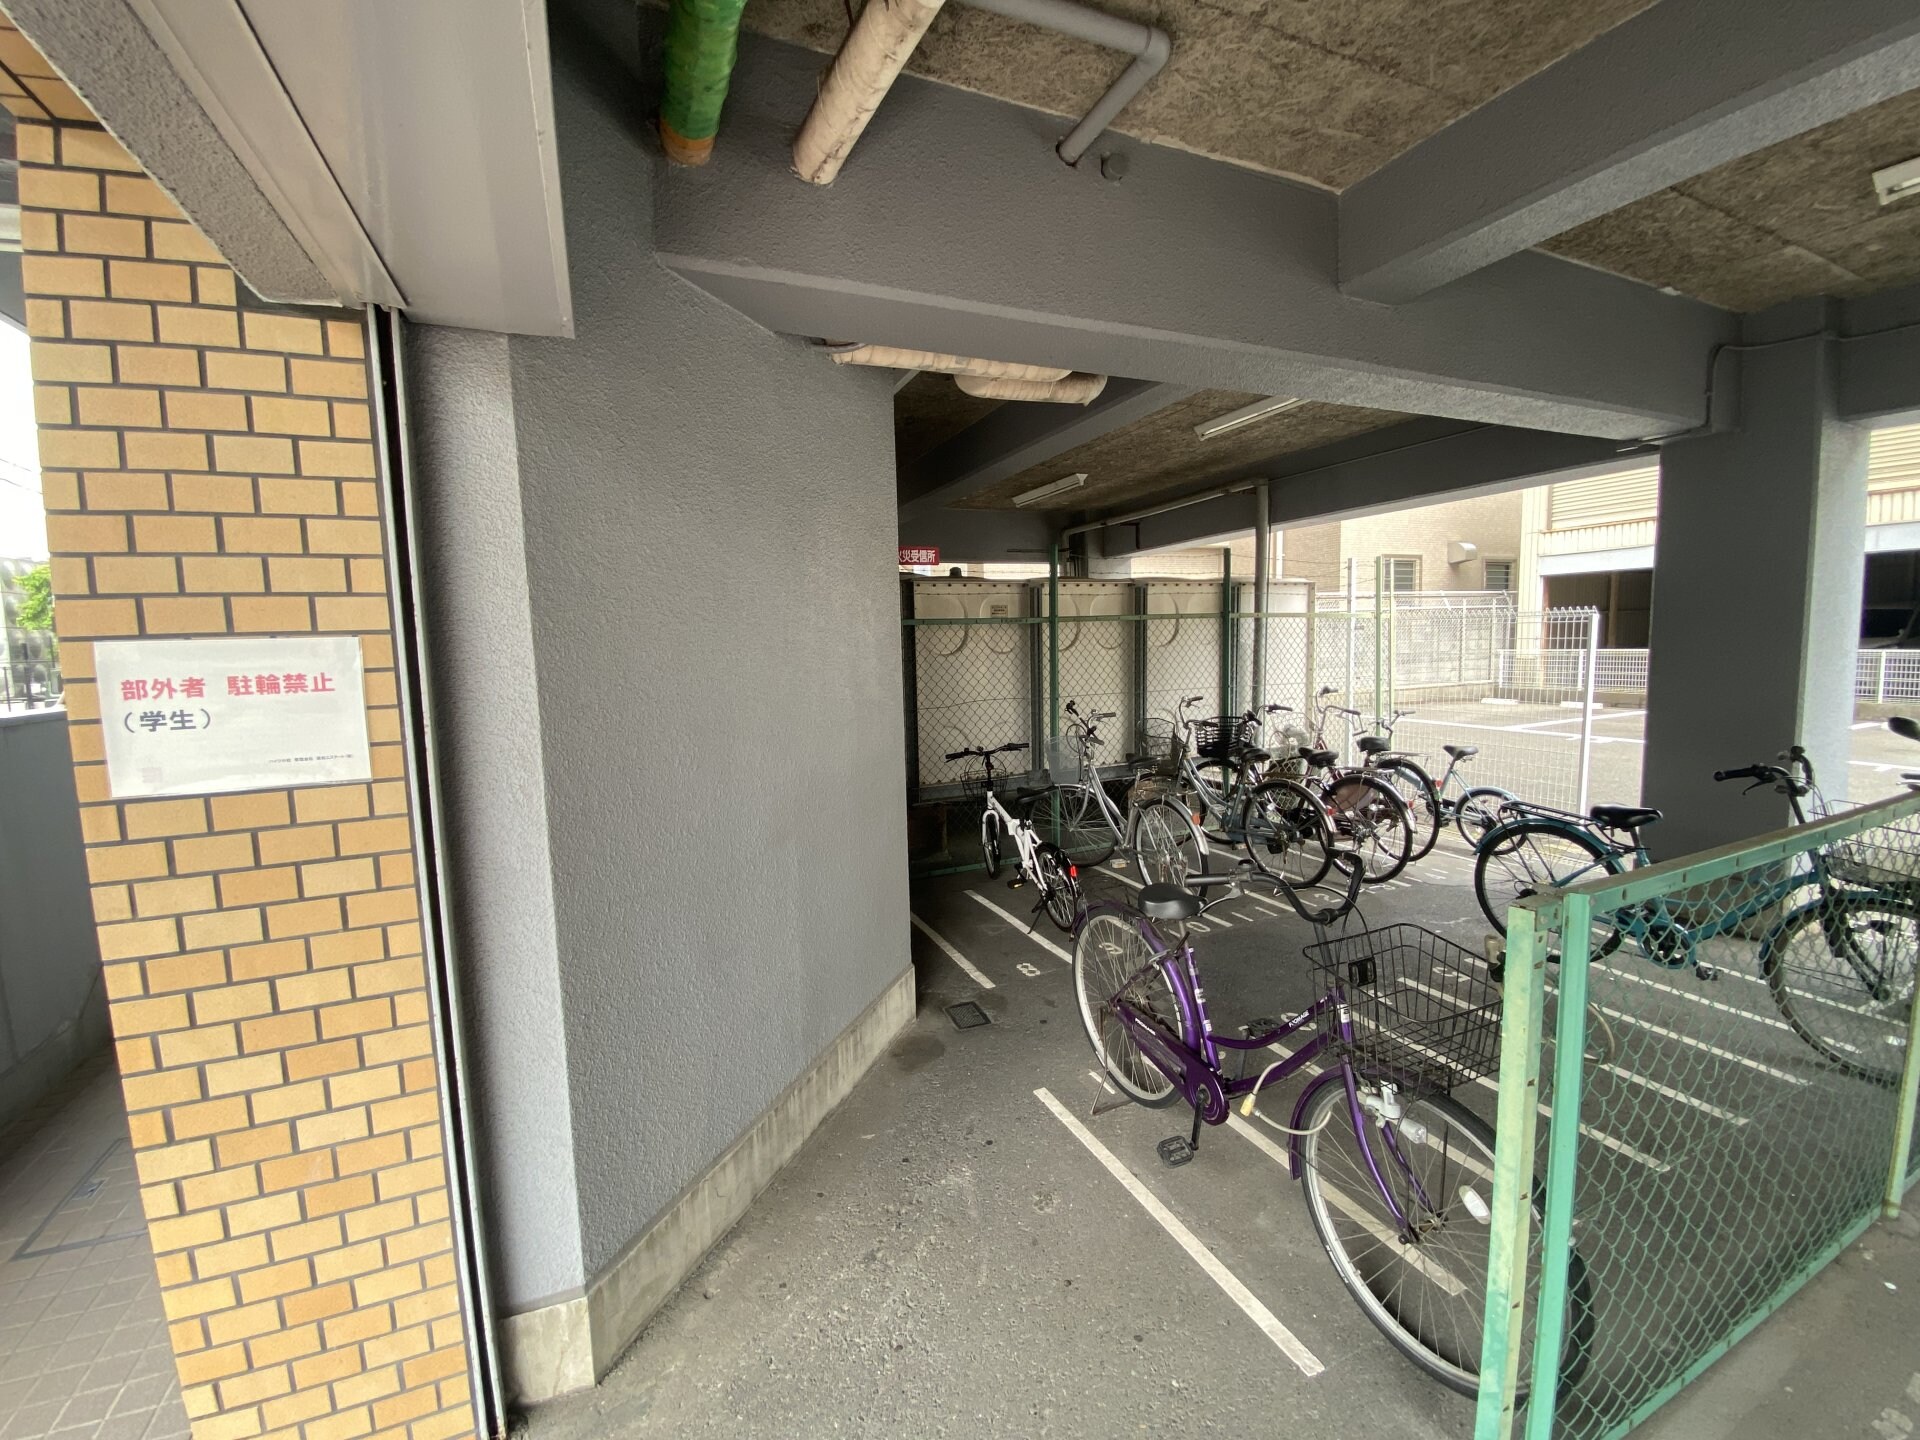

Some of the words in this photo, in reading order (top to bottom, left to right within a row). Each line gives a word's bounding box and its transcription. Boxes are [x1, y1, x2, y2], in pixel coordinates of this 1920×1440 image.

[121, 677, 205, 700] 部外者
[227, 672, 335, 696] 駐輪禁止
[124, 708, 211, 733] （学生）
[1016, 963, 1041, 977] 8
